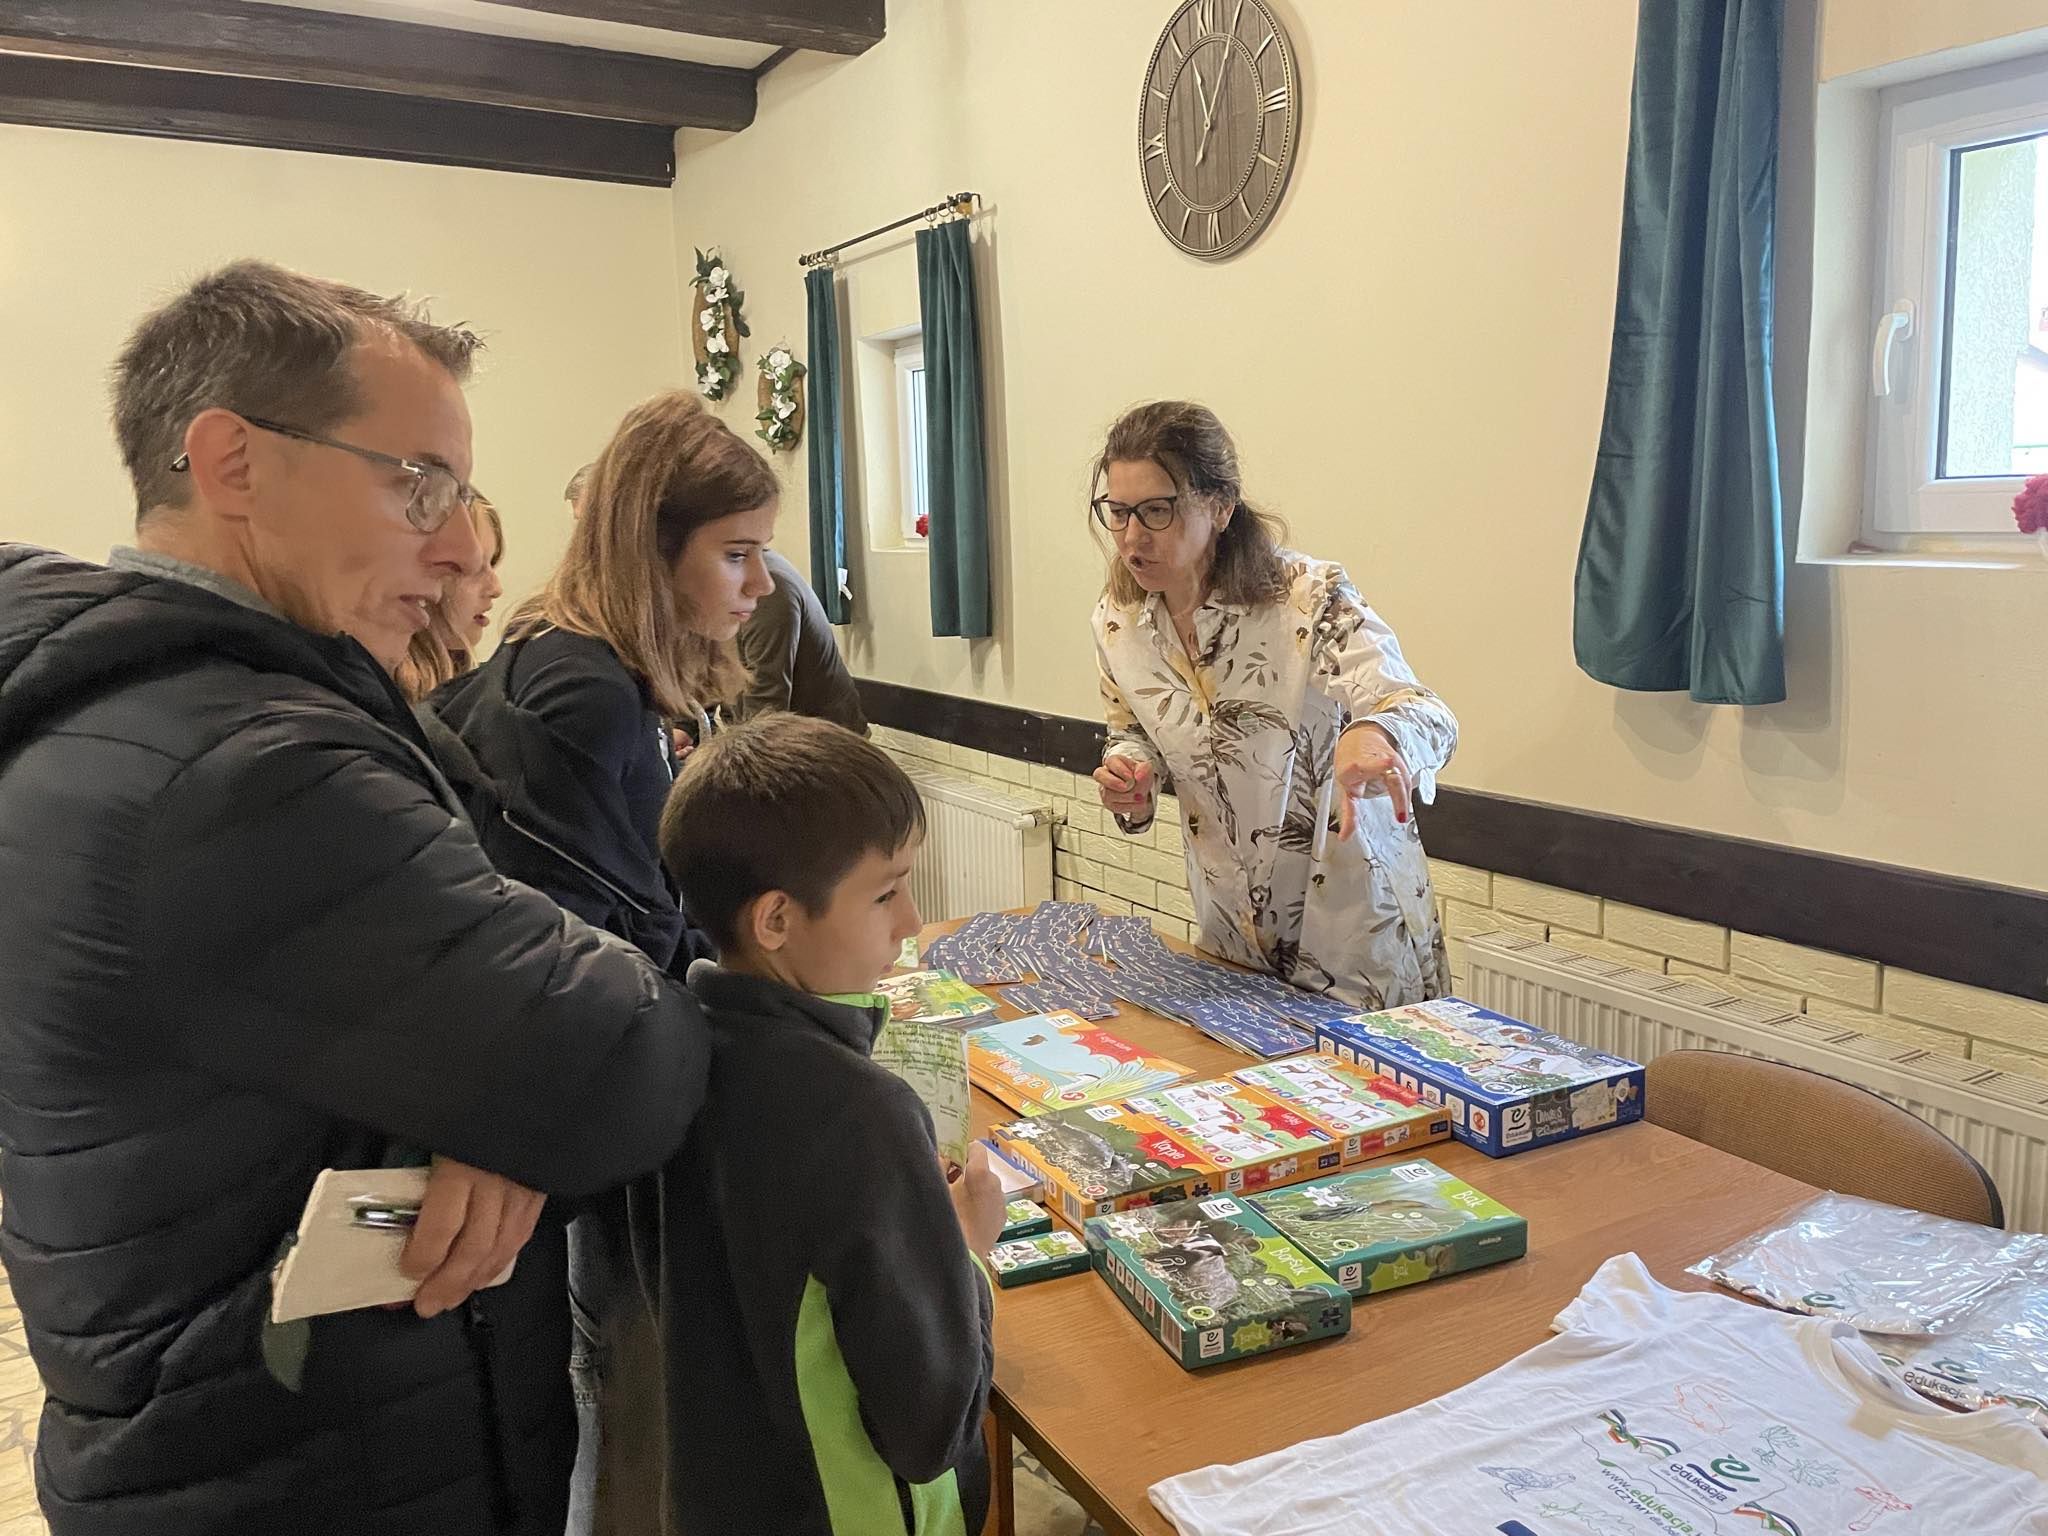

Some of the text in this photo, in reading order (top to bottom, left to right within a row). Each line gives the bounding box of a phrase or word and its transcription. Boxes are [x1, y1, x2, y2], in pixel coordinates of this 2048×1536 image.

[1269, 1247, 1312, 1277] Borsuk
[1670, 1463, 1728, 1502] edukacja
[1607, 1484, 1652, 1516] UCZYMY
